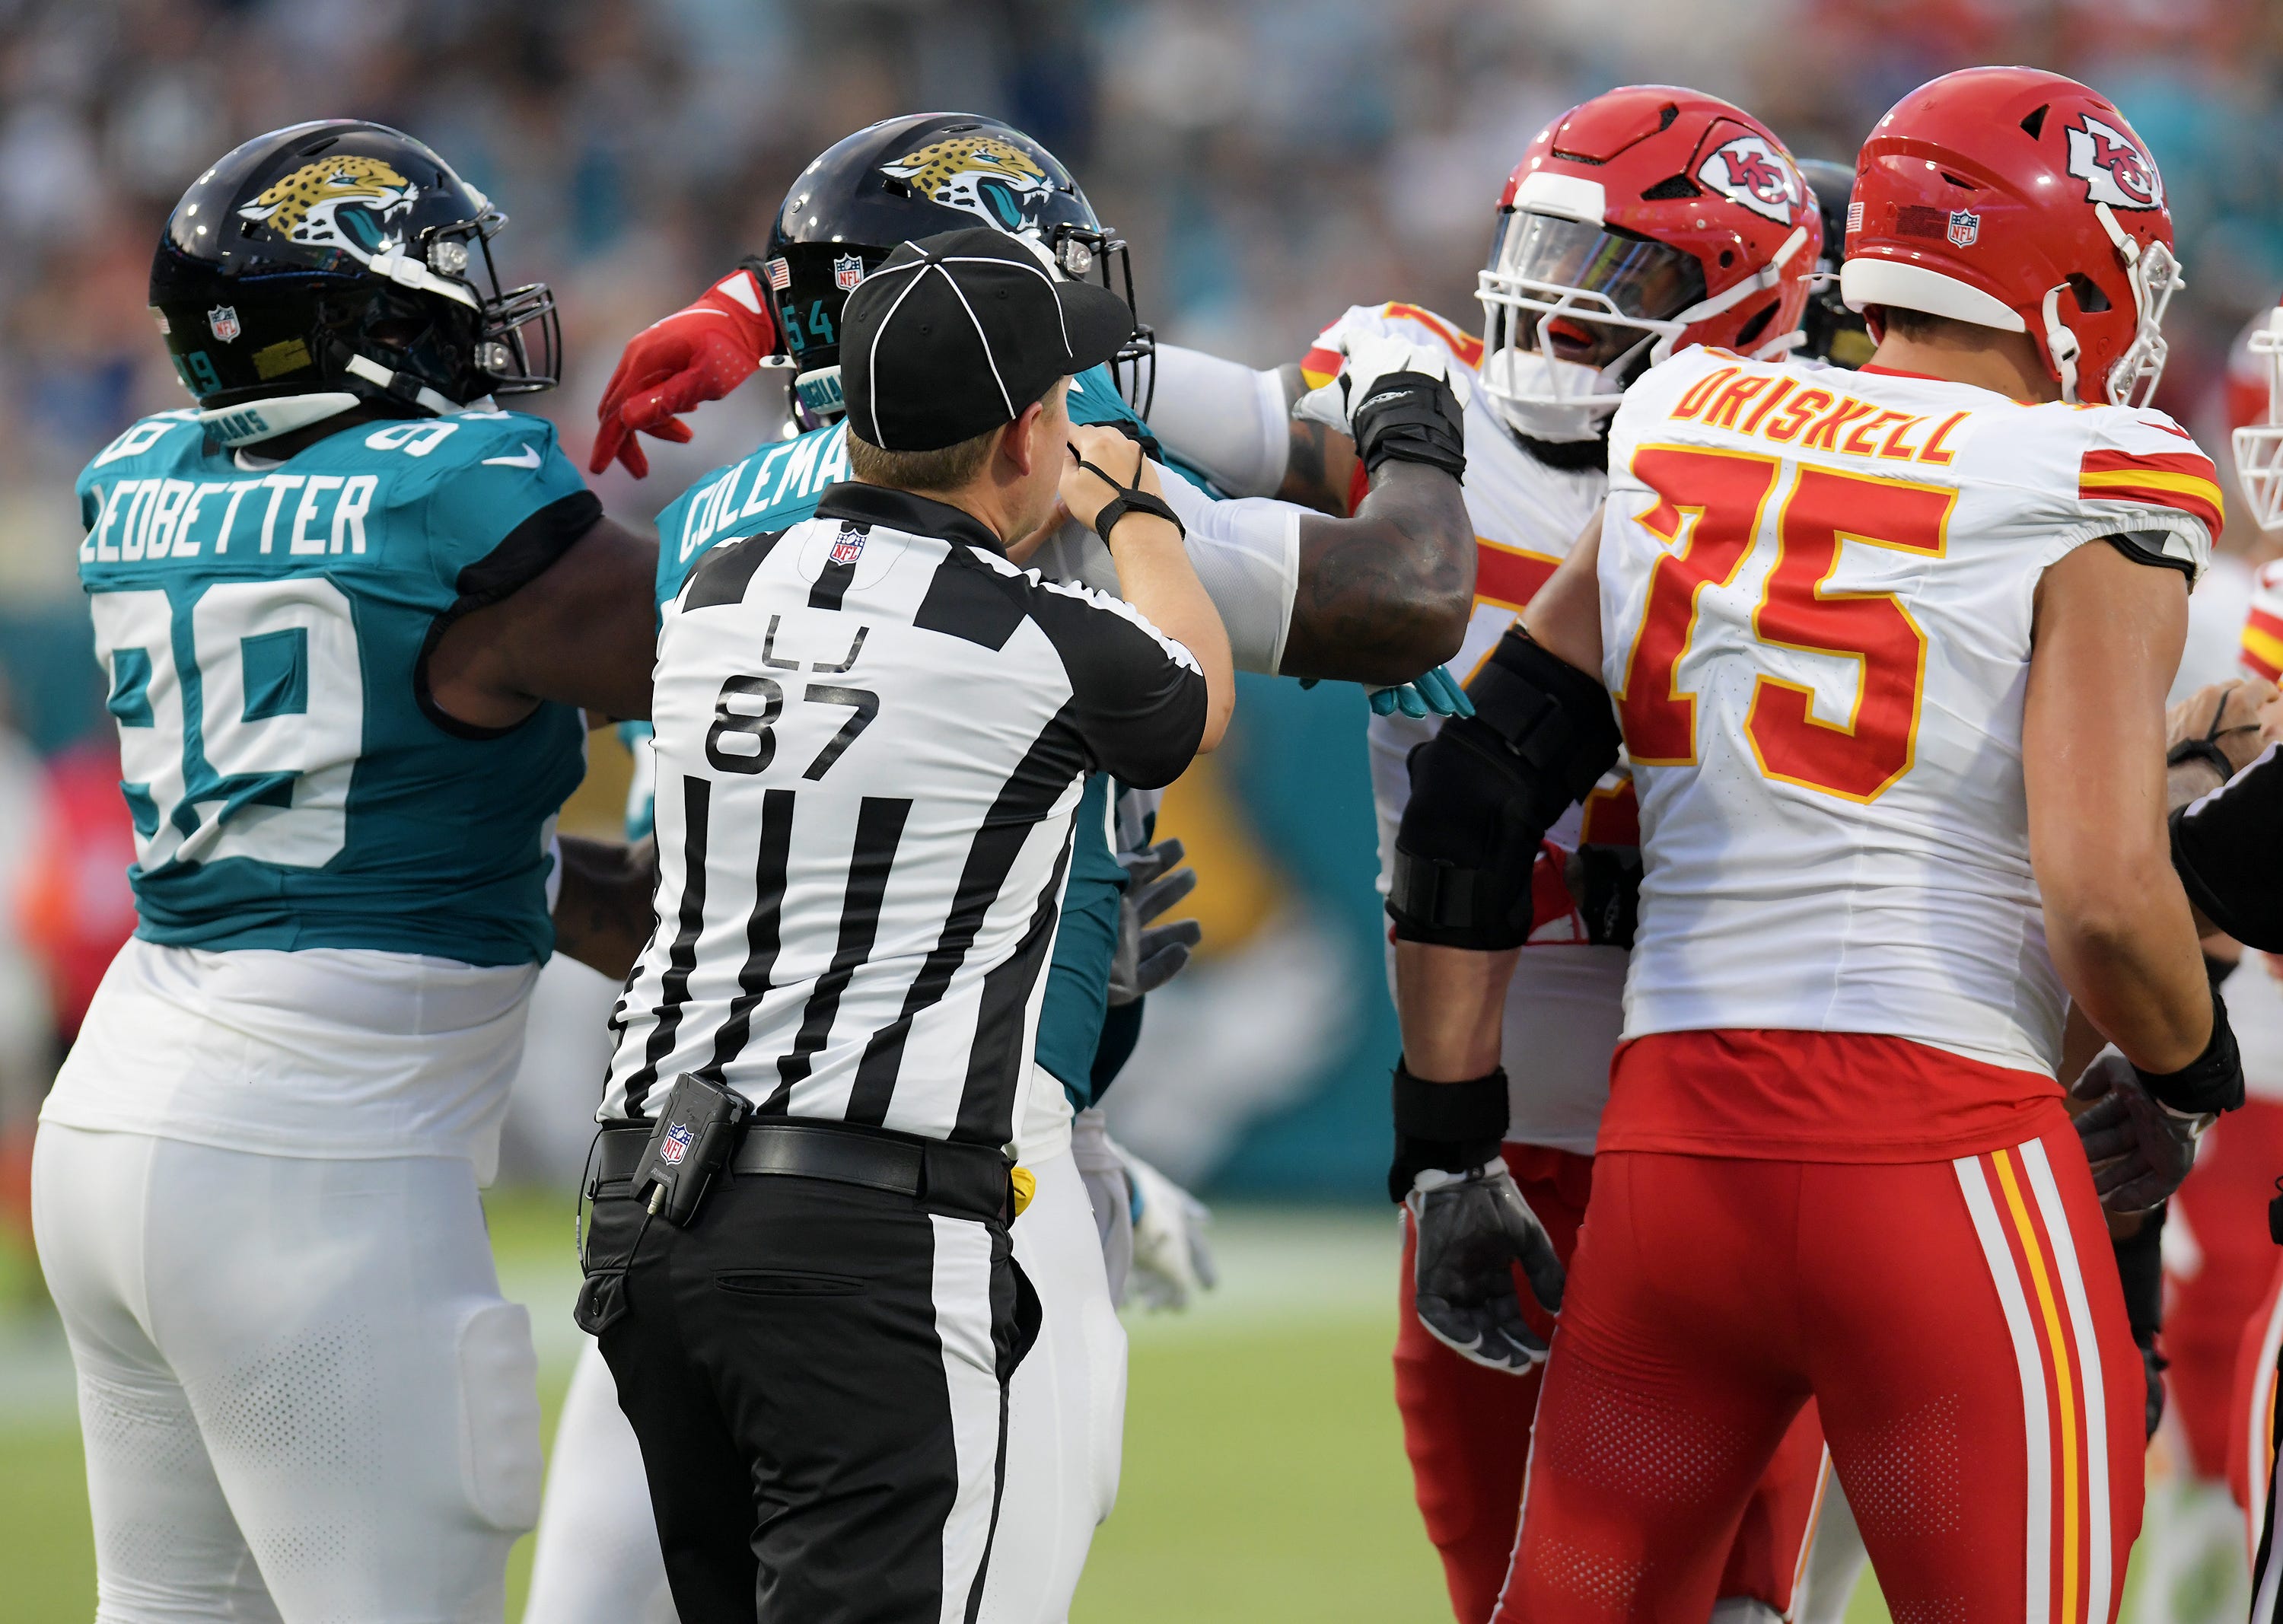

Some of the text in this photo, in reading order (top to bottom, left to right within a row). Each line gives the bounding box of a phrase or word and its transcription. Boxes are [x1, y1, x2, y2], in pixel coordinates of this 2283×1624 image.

[1951, 226, 1973, 242] NFL
[839, 271, 860, 287] NFL
[215, 320, 237, 336] NFL
[782, 300, 834, 351] 54
[1667, 365, 1972, 467] DRISKELL
[679, 420, 854, 564] COLEMA
[832, 543, 858, 561] NFL
[762, 615, 870, 673] LJ
[1613, 442, 1959, 805] 75
[91, 576, 364, 872] 99
[705, 674, 880, 782] 87
[664, 1137, 683, 1160] NFL
